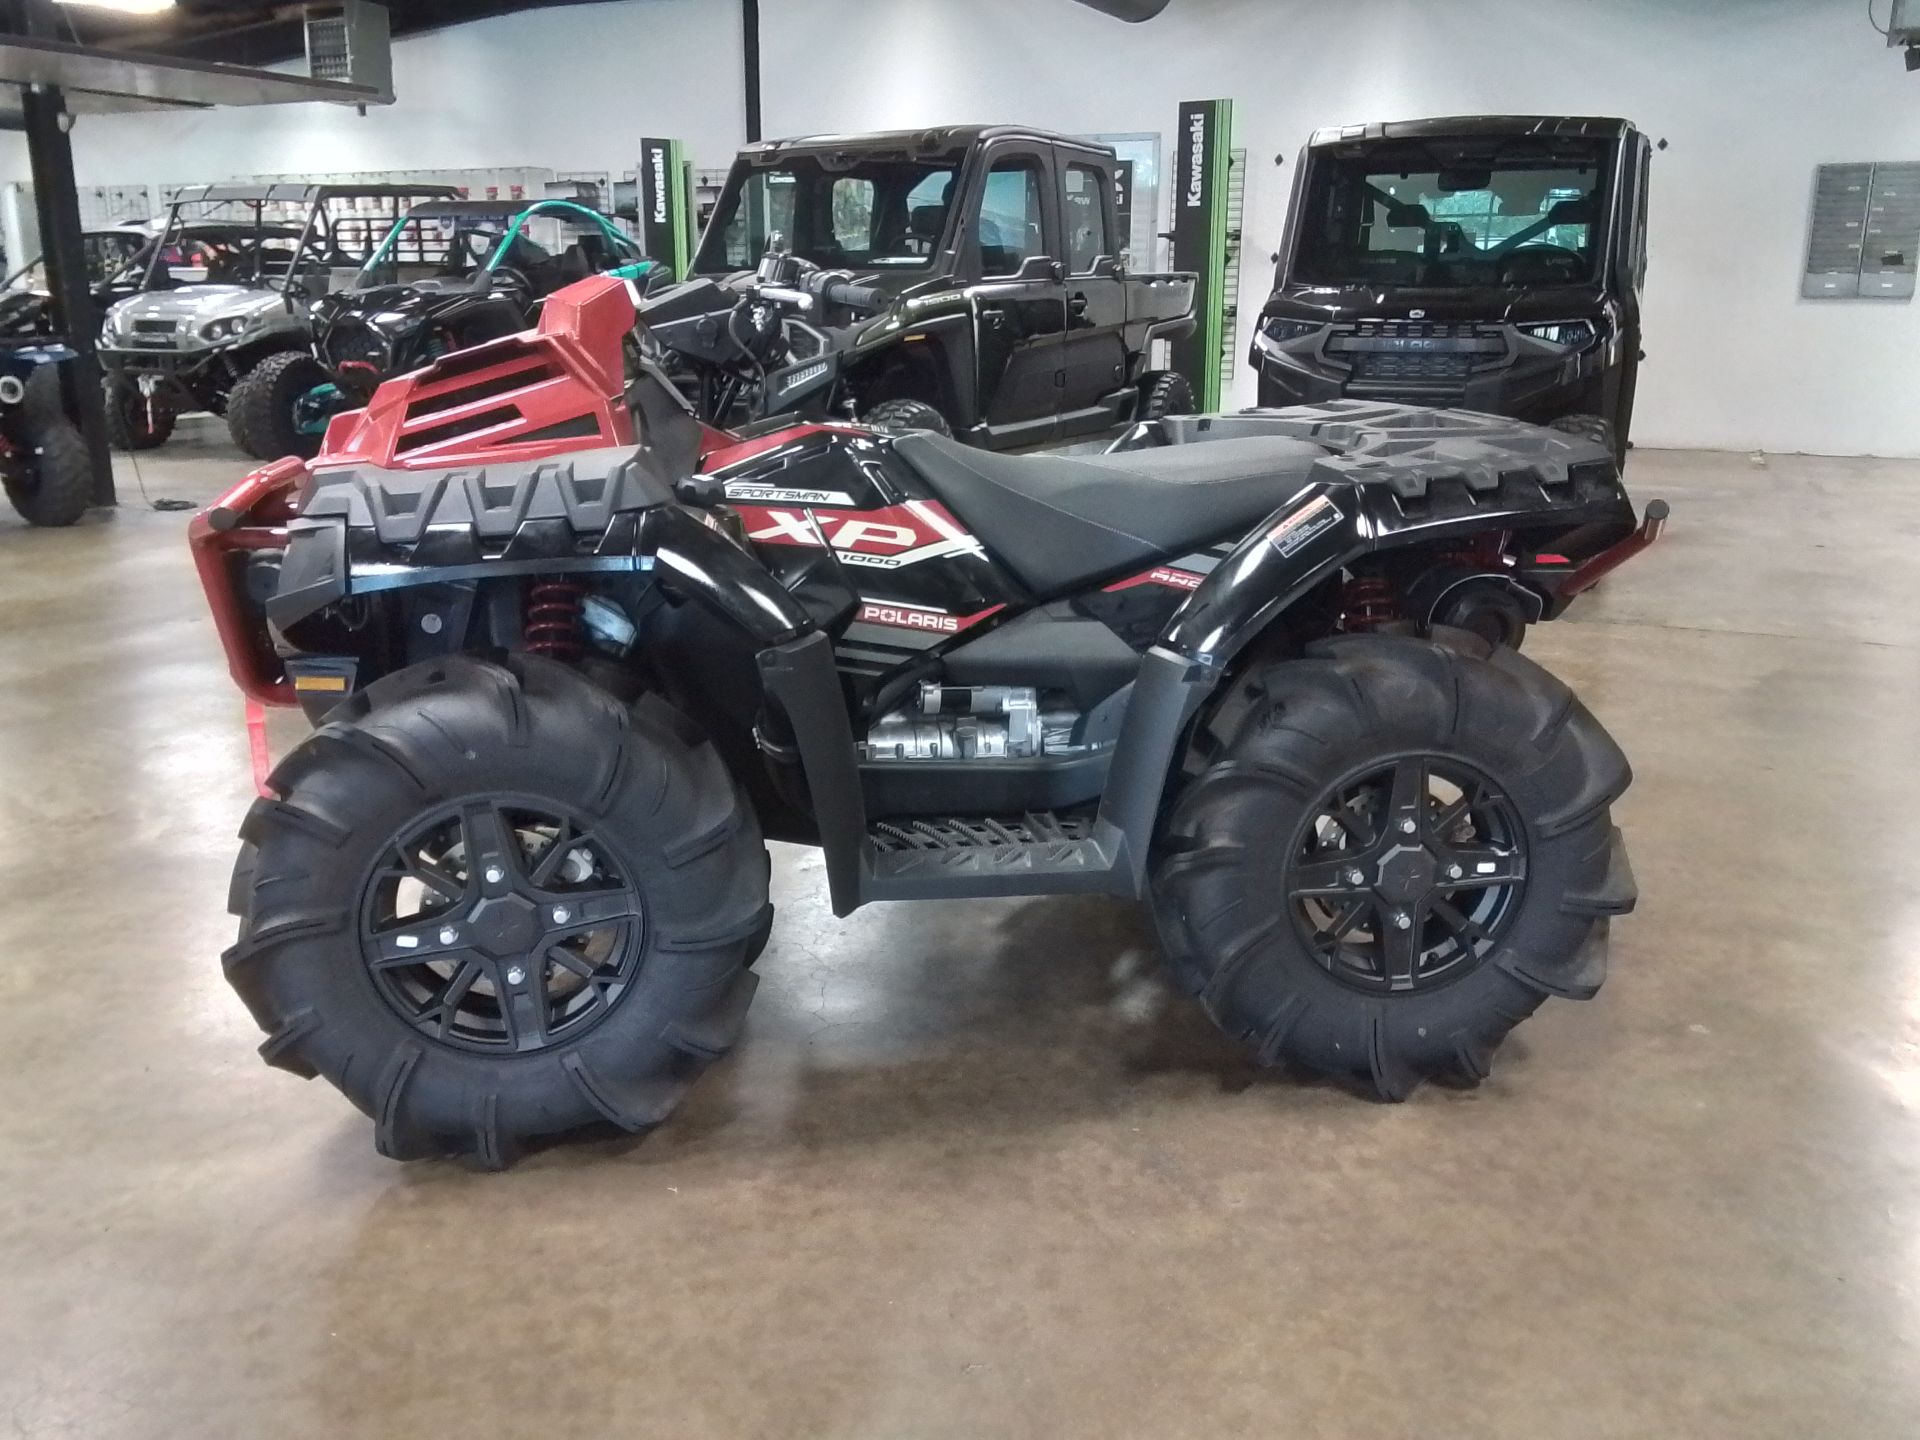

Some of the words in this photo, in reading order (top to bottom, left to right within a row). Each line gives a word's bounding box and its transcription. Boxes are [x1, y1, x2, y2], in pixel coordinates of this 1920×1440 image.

[1187, 113, 1205, 207] Kawasaki
[651, 148, 667, 223] Kawasaki
[727, 487, 830, 502] SPORTSMAN
[748, 510, 918, 549] XP
[842, 553, 902, 567] 1000
[864, 606, 959, 631] POLARIS
